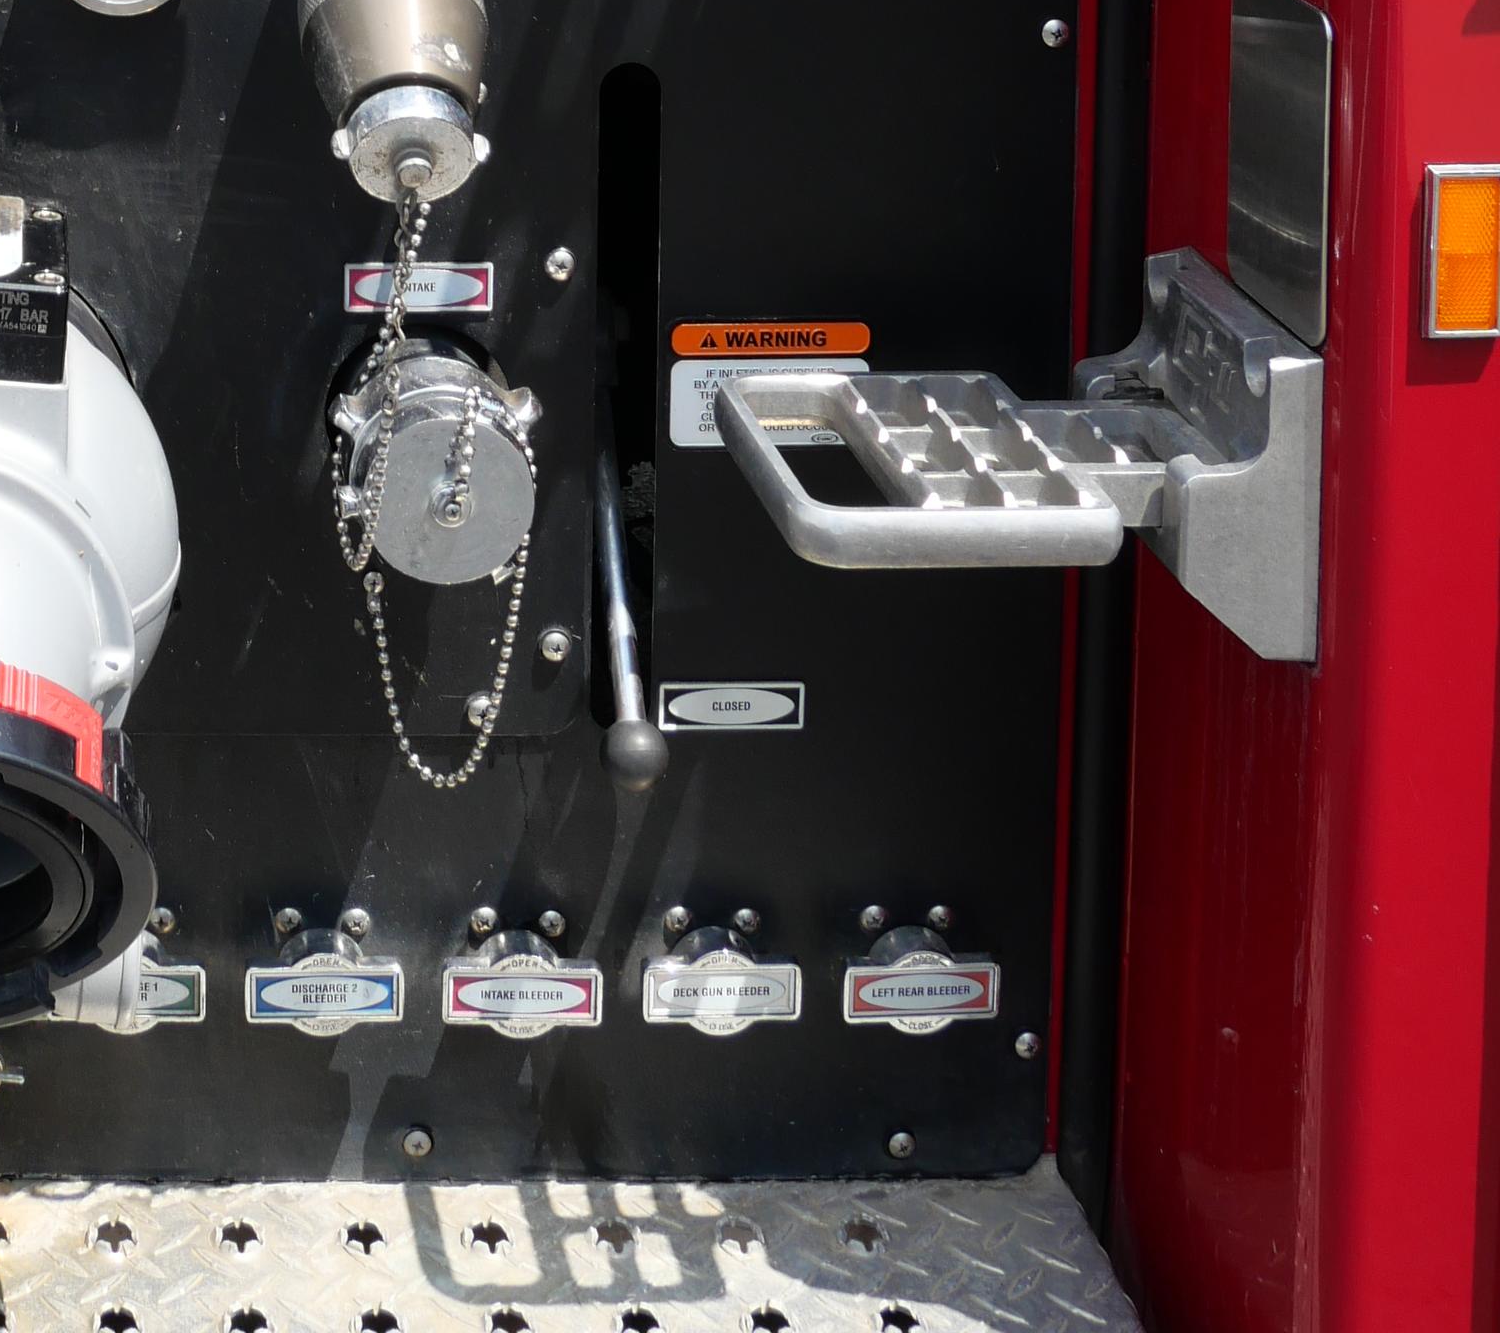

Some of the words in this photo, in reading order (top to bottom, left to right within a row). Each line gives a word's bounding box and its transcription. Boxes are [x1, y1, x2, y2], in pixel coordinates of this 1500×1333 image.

[0, 307, 11, 320] 17
[20, 310, 48, 323] BAR
[726, 331, 827, 348] WARNING
[711, 701, 750, 711] CLOSED
[291, 984, 348, 994] DISCHARGE
[351, 984, 357, 993] 2
[673, 987, 699, 998] DECK
[702, 986, 724, 997] GUN
[726, 986, 770, 997] BLEEDER
[872, 987, 895, 998] LEFT
[897, 986, 924, 997] REAR
[927, 985, 970, 996] BLEEDER
[303, 993, 347, 1004] BLEEDER
[480, 990, 516, 1000] INTAKE
[518, 990, 563, 1001] BLEEDER
